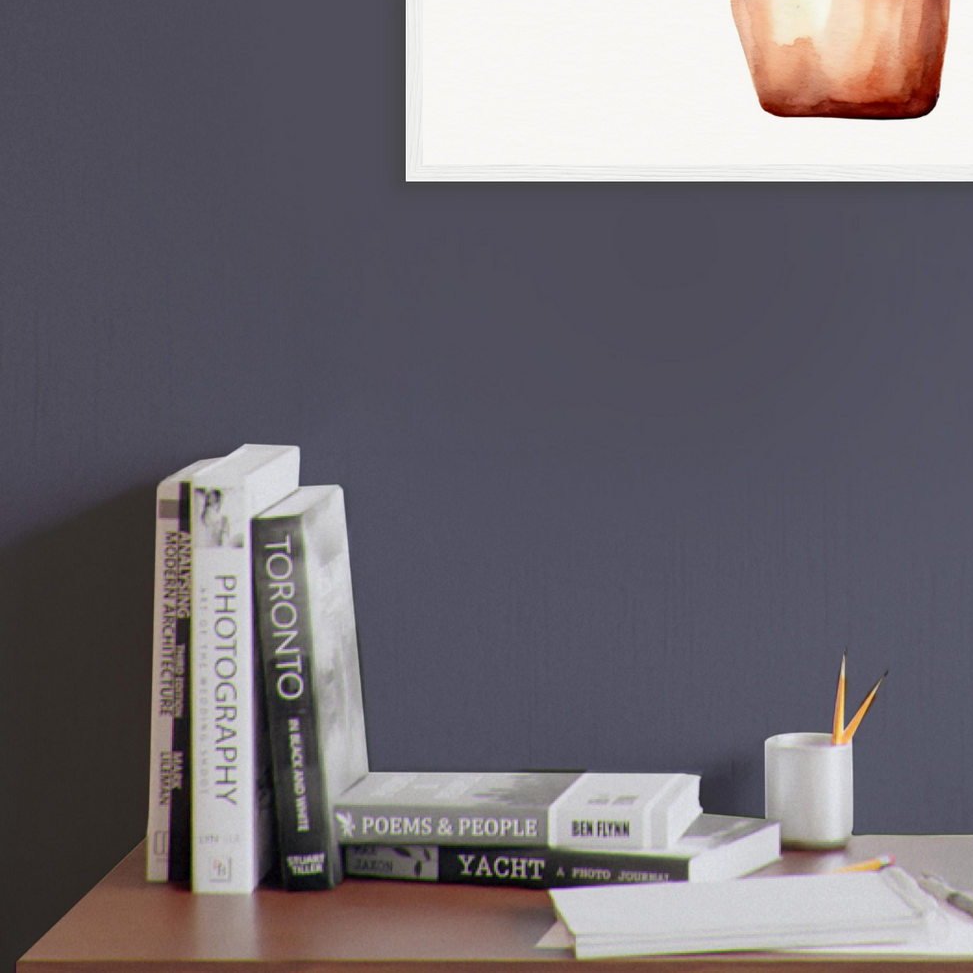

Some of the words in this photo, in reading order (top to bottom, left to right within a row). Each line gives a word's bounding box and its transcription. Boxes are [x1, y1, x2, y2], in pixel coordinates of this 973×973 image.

[163, 530, 178, 599] MODERN
[177, 530, 192, 619] ANALYSING
[264, 533, 304, 701] TORONTO
[160, 603, 176, 716] ARCHITECTURE
[174, 643, 185, 676] THIRD
[199, 644, 208, 669] THE
[173, 676, 184, 718] EDITION
[214, 574, 238, 805] PHOTOGRAPHY
[199, 676, 208, 742] WEDDING
[288, 718, 300, 732] IN
[289, 732, 304, 768] BLACK
[171, 751, 183, 790] MARK
[293, 769, 306, 796] AND
[295, 796, 310, 832] WHITE
[361, 817, 433, 837] POEMS
[437, 818, 453, 837] &
[458, 818, 538, 838] PEOPLE
[571, 820, 593, 837] BEN
[597, 820, 630, 837] FLYNN
[286, 852, 325, 865] STUART
[457, 853, 546, 880] YACHT
[556, 866, 565, 878] A
[572, 867, 611, 880] PHOTO
